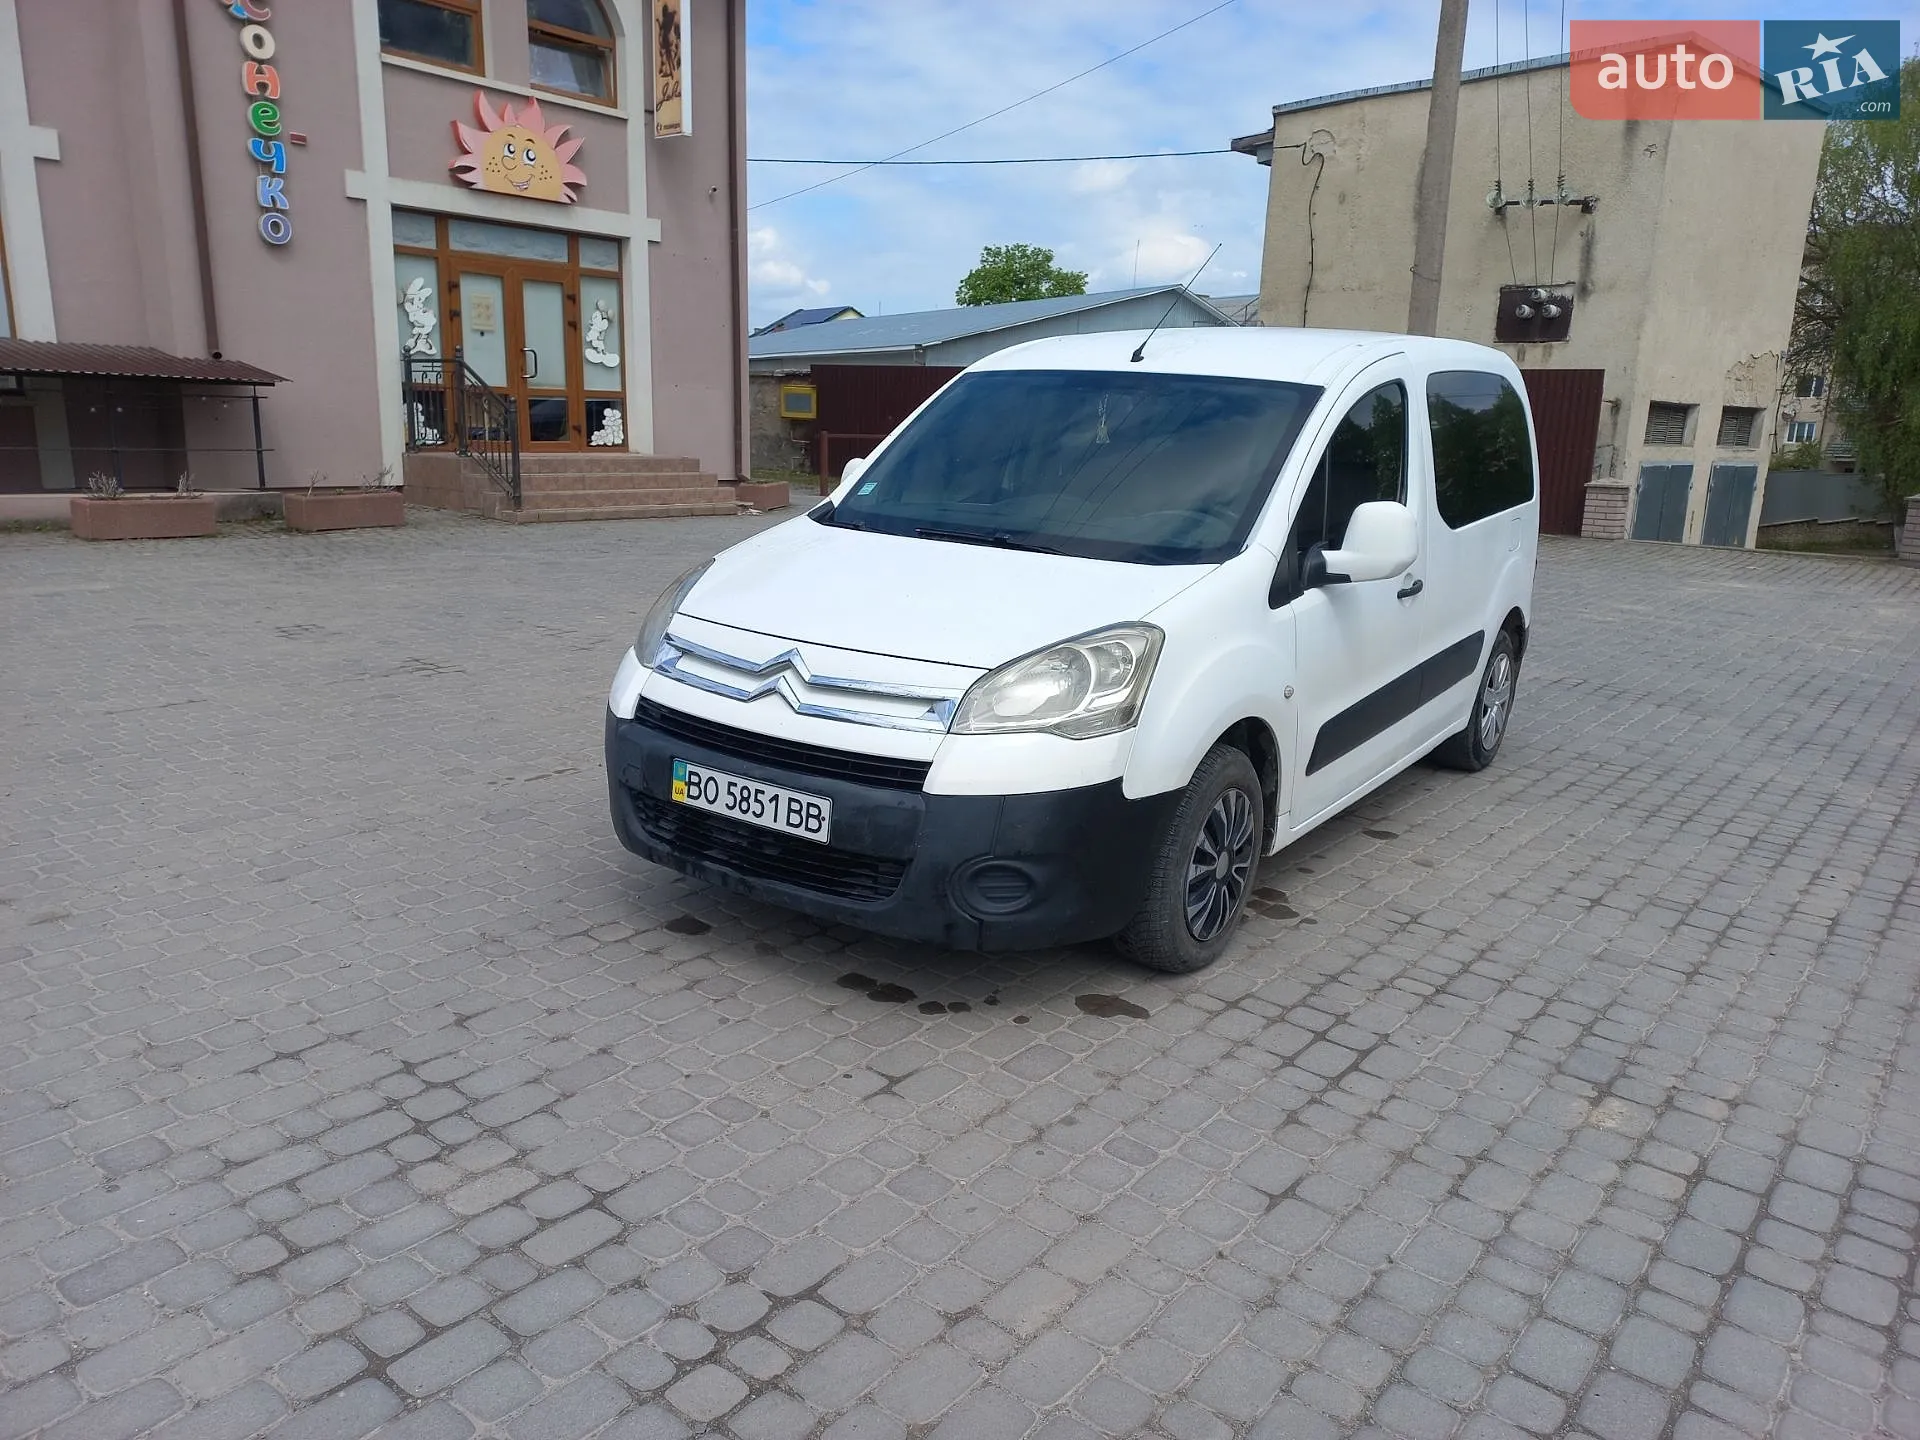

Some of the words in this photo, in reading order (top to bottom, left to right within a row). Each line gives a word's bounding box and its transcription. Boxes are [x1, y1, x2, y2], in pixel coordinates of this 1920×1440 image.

[674, 786, 685, 796] UA
[686, 769, 719, 805] BO
[725, 781, 780, 823] 5851
[785, 796, 824, 834] BB
